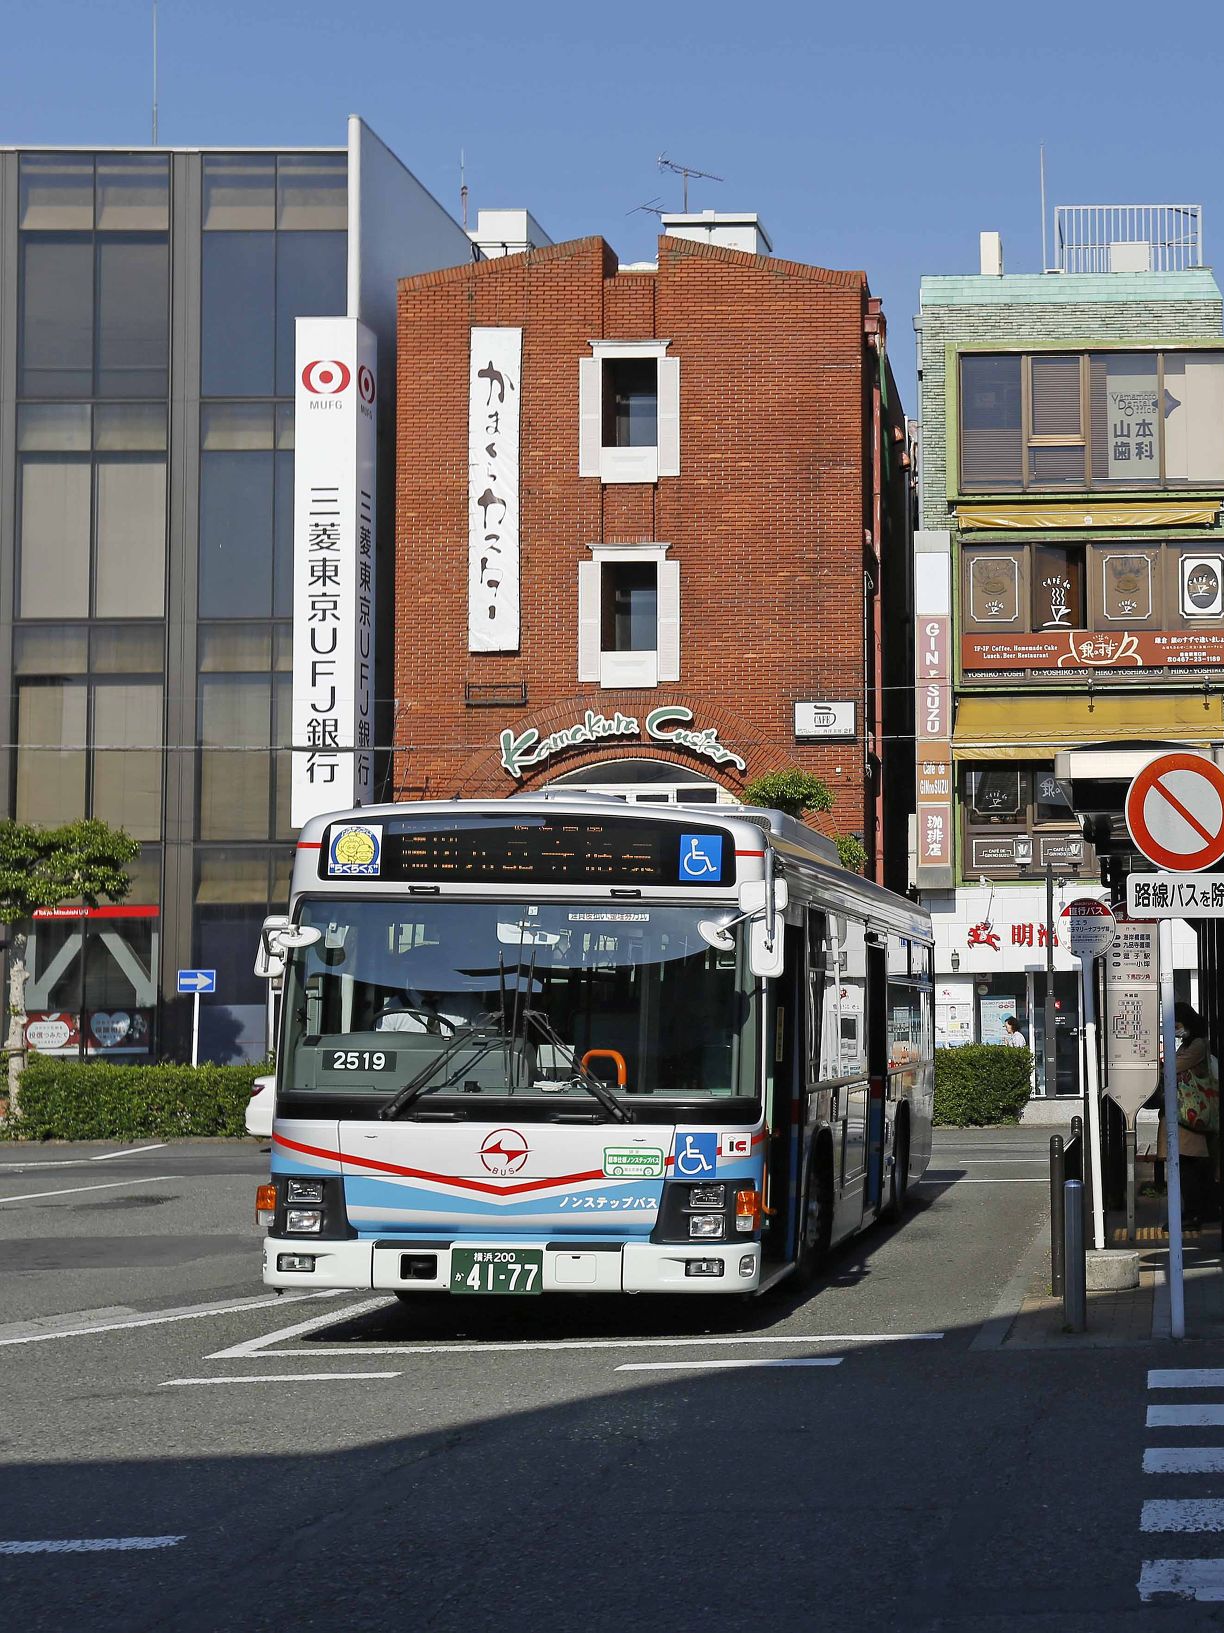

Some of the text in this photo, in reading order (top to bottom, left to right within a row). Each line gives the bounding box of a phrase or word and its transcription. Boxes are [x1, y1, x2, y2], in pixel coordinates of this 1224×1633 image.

[309, 399, 343, 411] MUFG
[1113, 419, 1154, 439] 山本
[1113, 440, 1154, 461] 歯科
[477, 359, 516, 621] かまくらカスター
[305, 486, 342, 784] 三菱東京UFJ銀行
[356, 491, 373, 788] 三菱東京UFJ銀行
[499, 709, 641, 779] Kamakura
[924, 815, 945, 857] 珈琲店
[332, 1051, 387, 1073] 2519
[491, 1167, 515, 1176] BUS
[559, 1196, 658, 1209] ノンステップバス
[473, 1252, 516, 1263] 横浜200
[454, 1263, 539, 1291] か 41-77
